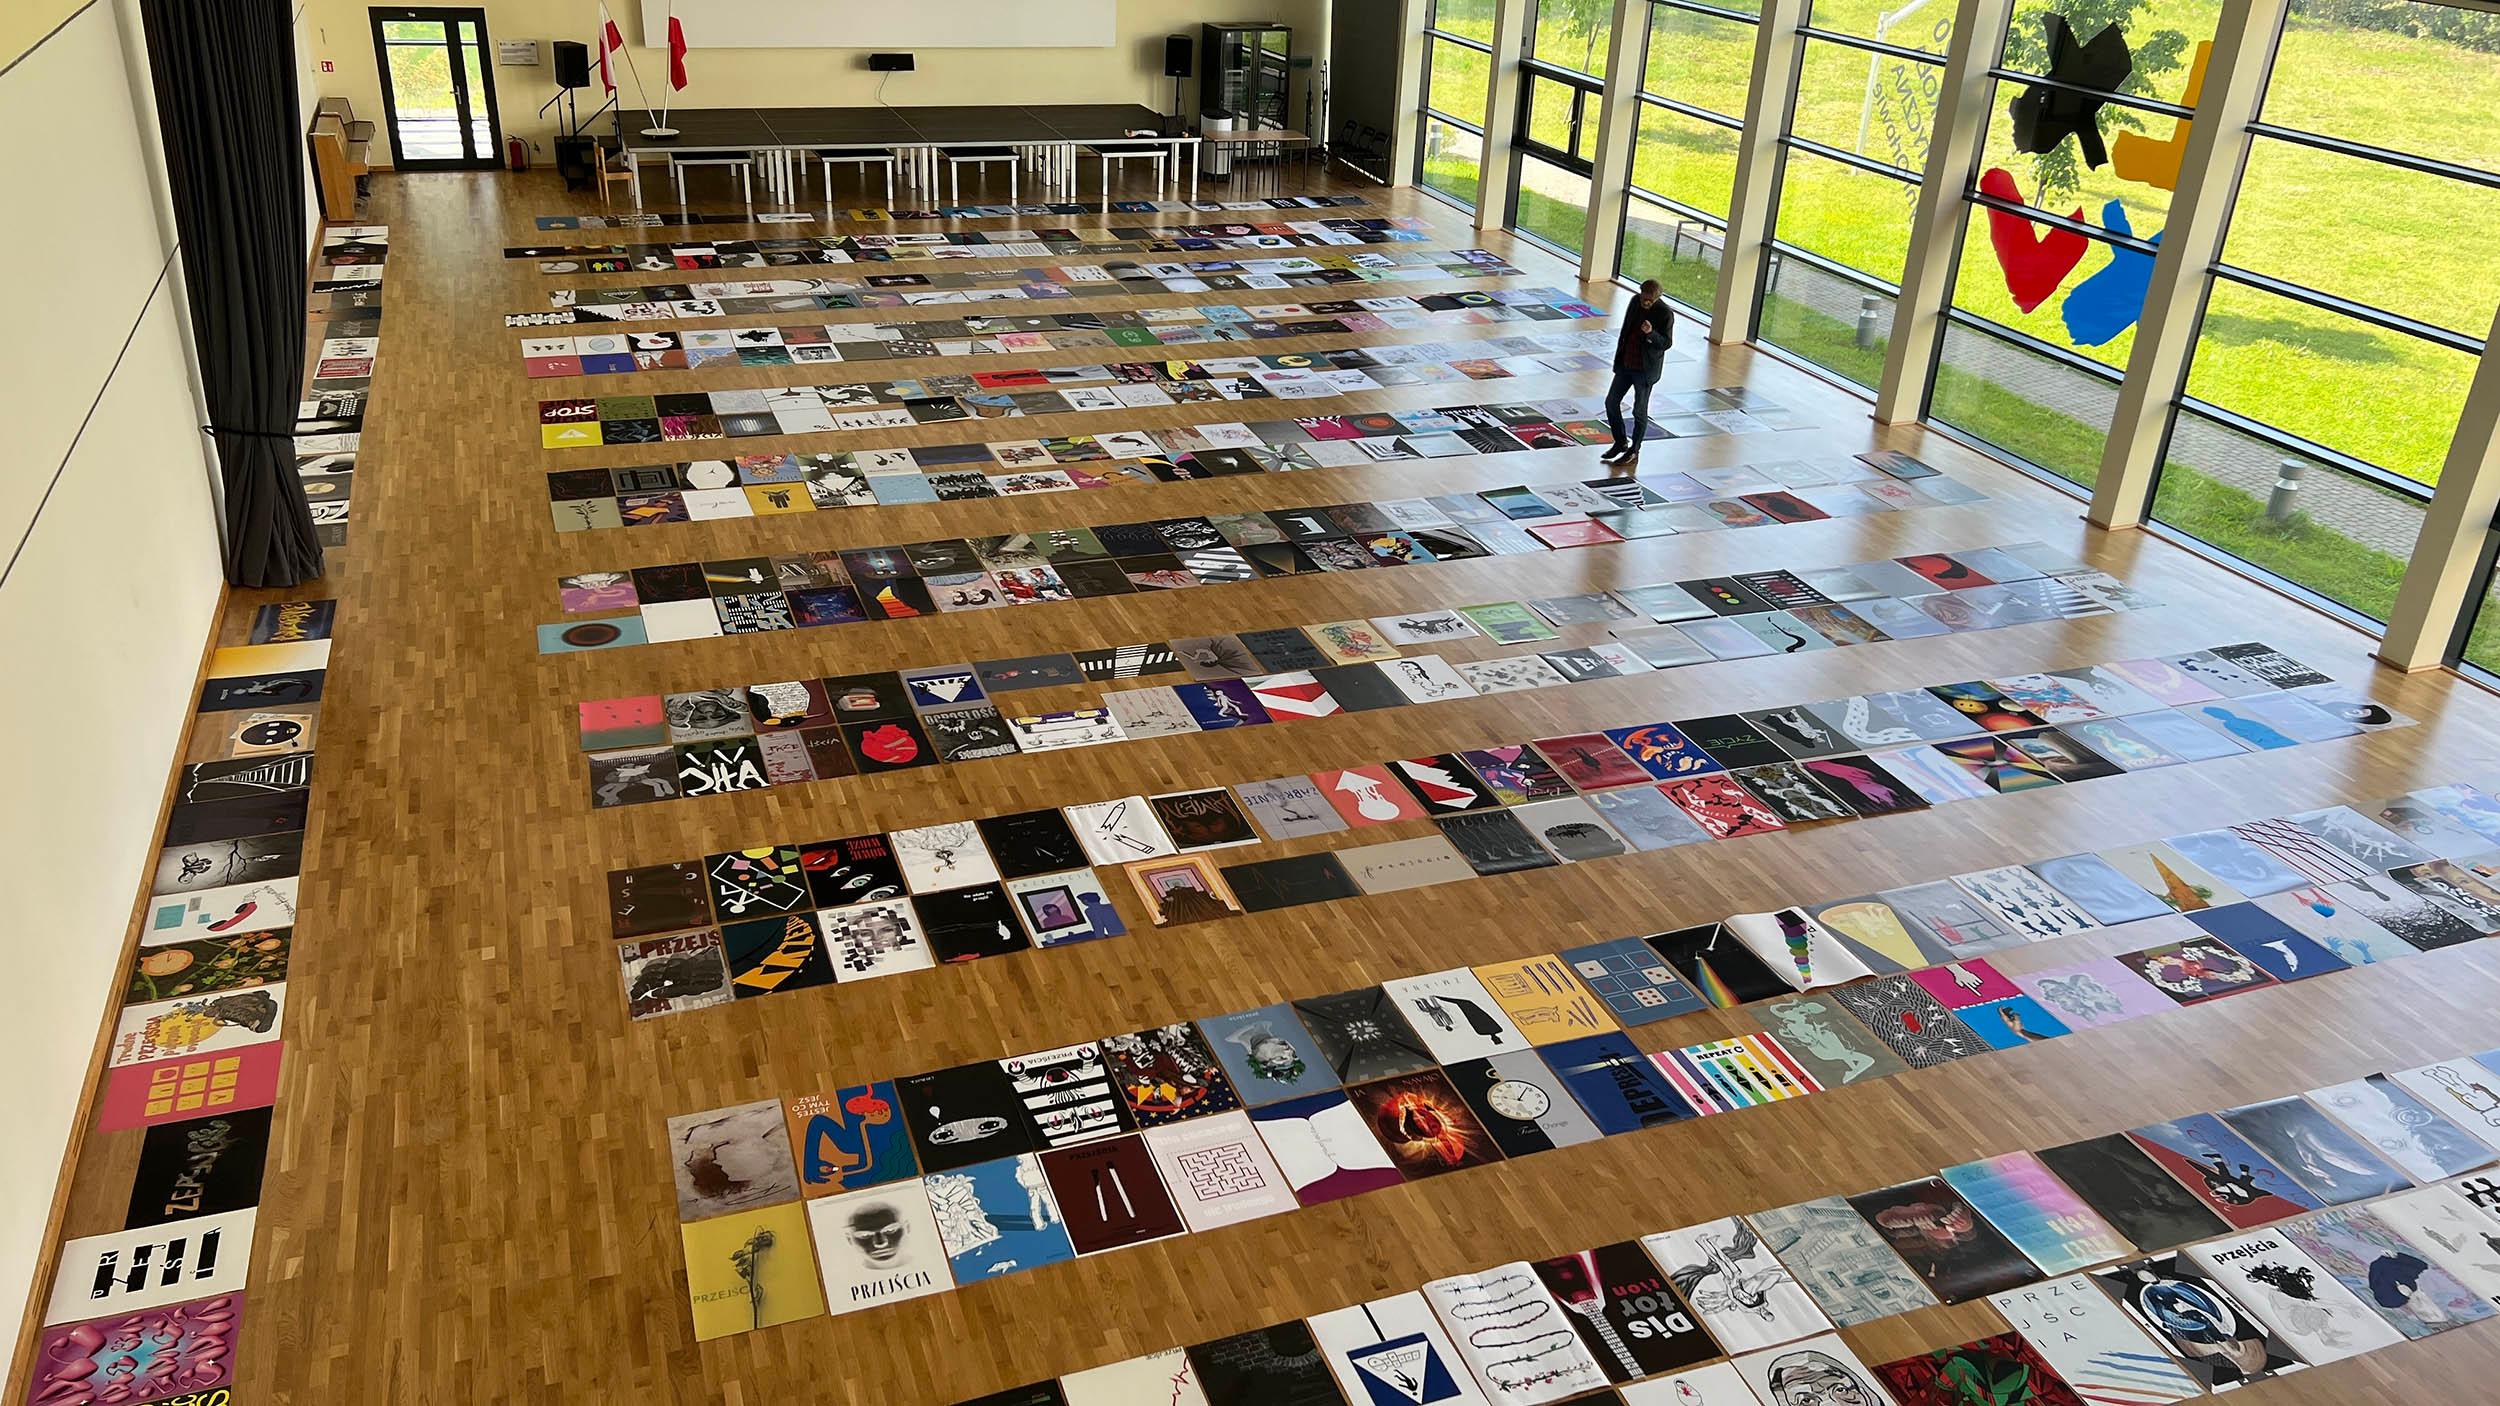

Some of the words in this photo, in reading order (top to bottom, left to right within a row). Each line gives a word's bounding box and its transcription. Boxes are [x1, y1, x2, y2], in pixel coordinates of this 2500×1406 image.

[545, 403, 597, 418] STOP
[1696, 1047, 1735, 1062] REPEAT
[797, 1094, 823, 1106] JESZ
[2211, 1236, 2280, 1268] przejścia
[851, 1270, 932, 1302] PRZEJŚCIA
[1611, 1276, 1662, 1298] tion
[1620, 1288, 1682, 1316] tor
[1630, 1311, 1695, 1342] Dis
